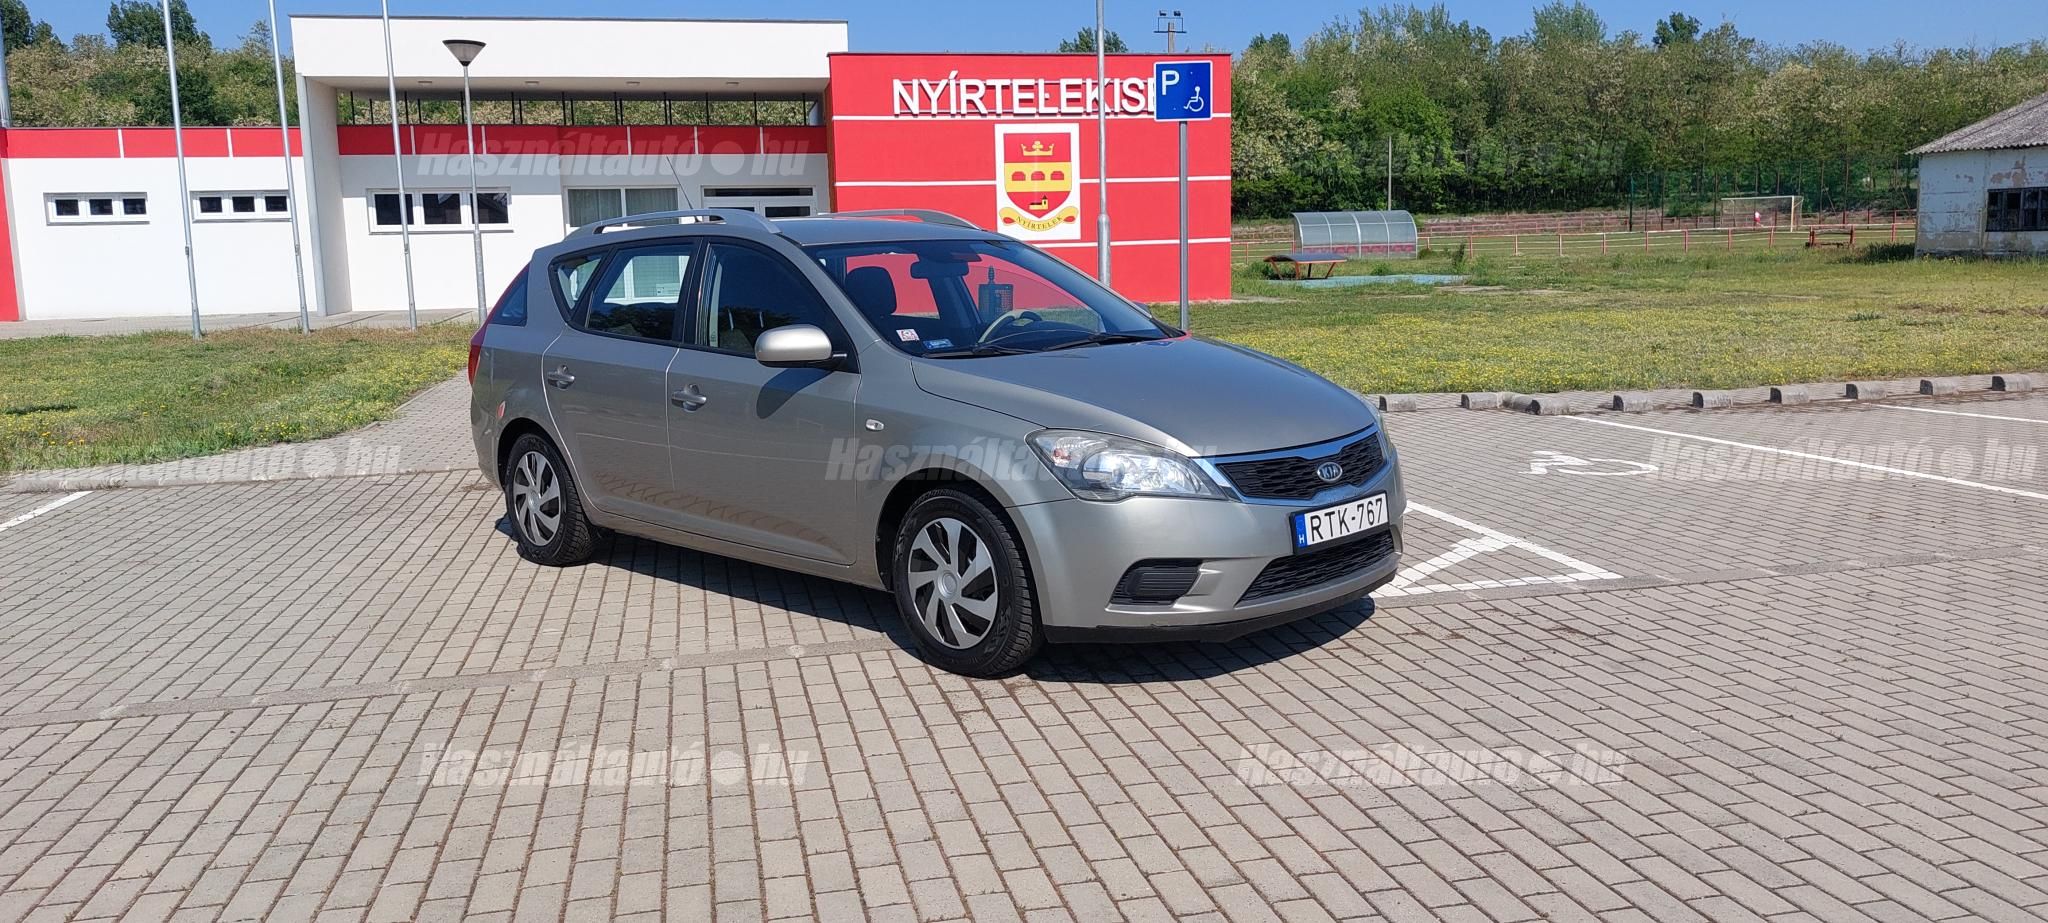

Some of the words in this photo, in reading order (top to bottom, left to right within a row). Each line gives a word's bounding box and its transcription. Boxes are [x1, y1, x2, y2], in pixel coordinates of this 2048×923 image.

[1162, 70, 1180, 96] P
[1320, 464, 1340, 480] KIA
[1310, 499, 1382, 542] RTK-767
[1299, 534, 1305, 544] H
